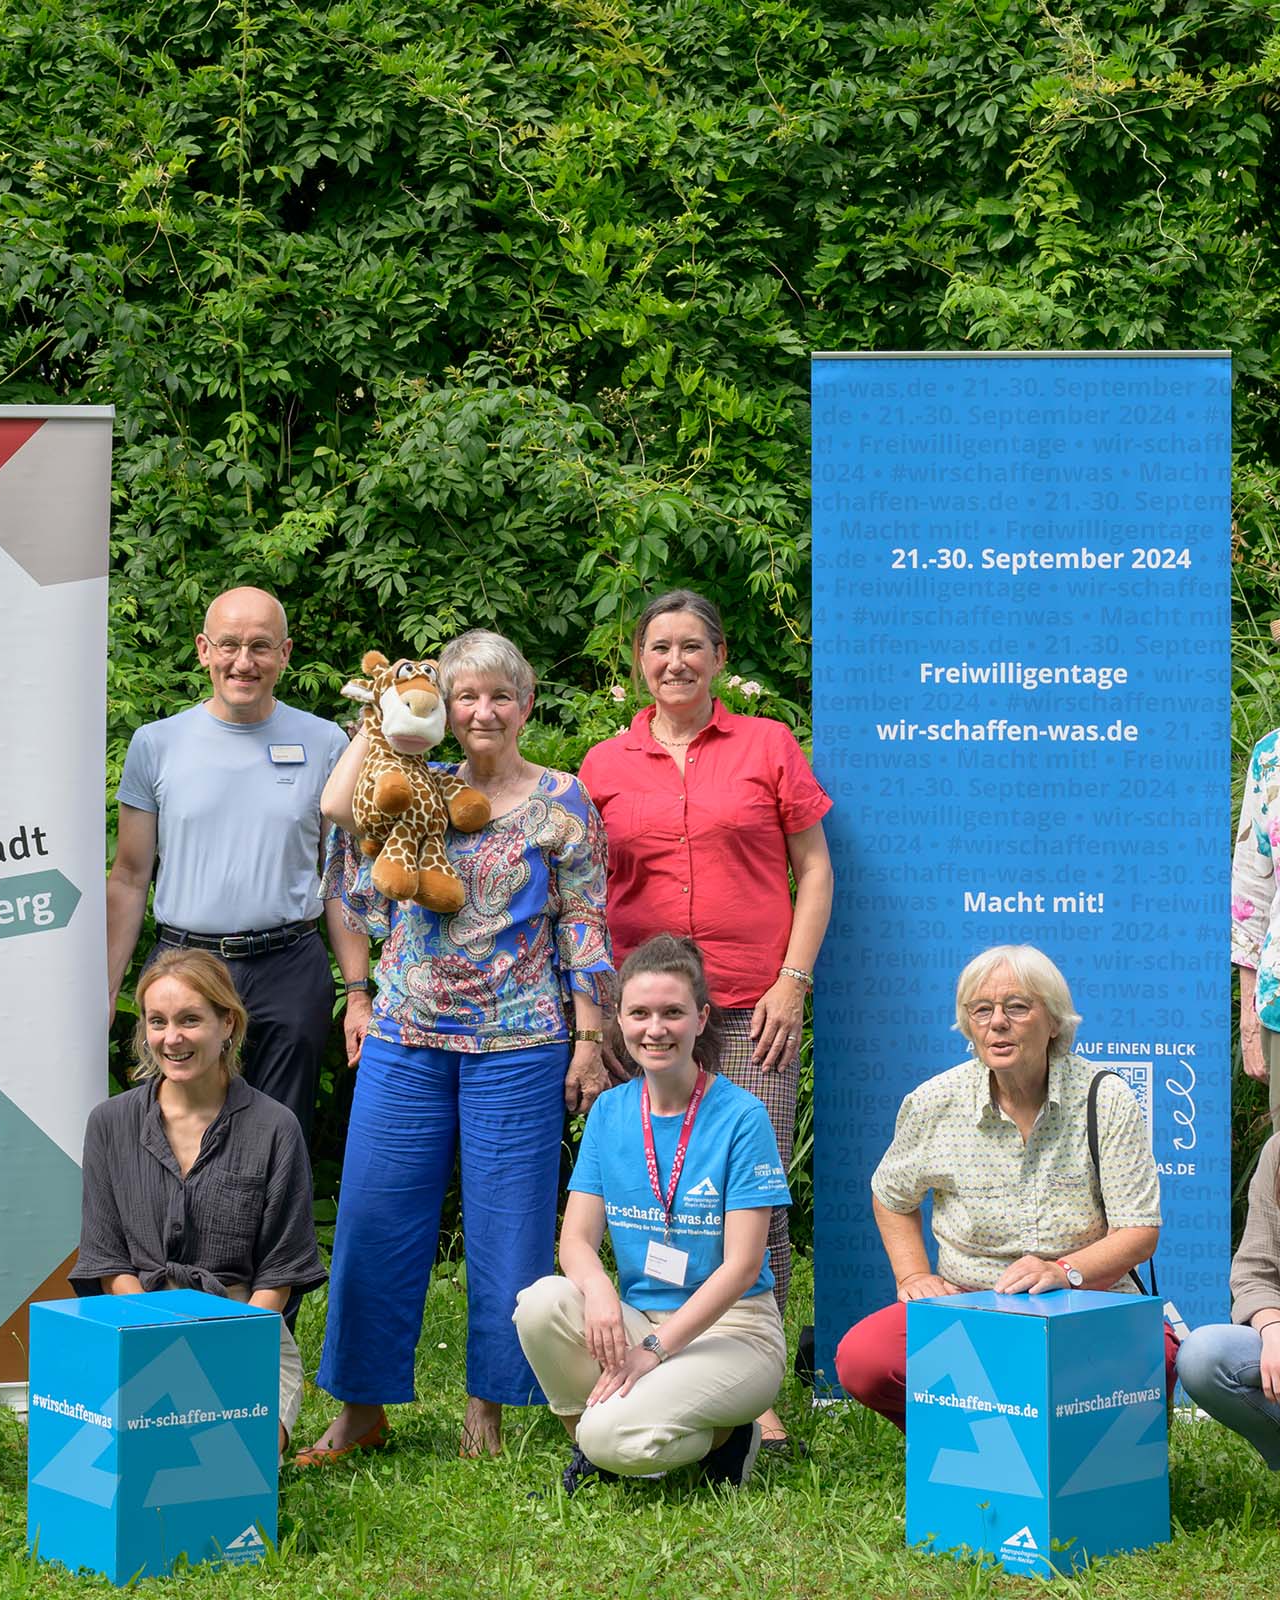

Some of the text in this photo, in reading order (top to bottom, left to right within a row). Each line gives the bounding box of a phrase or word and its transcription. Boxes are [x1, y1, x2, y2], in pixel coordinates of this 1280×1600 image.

[891, 547, 1191, 575] 21.-30. September 2024
[921, 662, 1128, 690] Freiwilligentage
[876, 719, 1138, 741] wir-schaffen-was.de
[964, 891, 1104, 913] Macht mit!
[1075, 1043, 1196, 1056] AUF EINEN BLICK
[32, 1393, 112, 1429] #wirschaffenwas
[913, 1389, 1039, 1418] wir-schaffen-was.de
[1055, 1386, 1161, 1418] #wirschaffenwas
[127, 1403, 269, 1431] wir-schaffen-was.de
